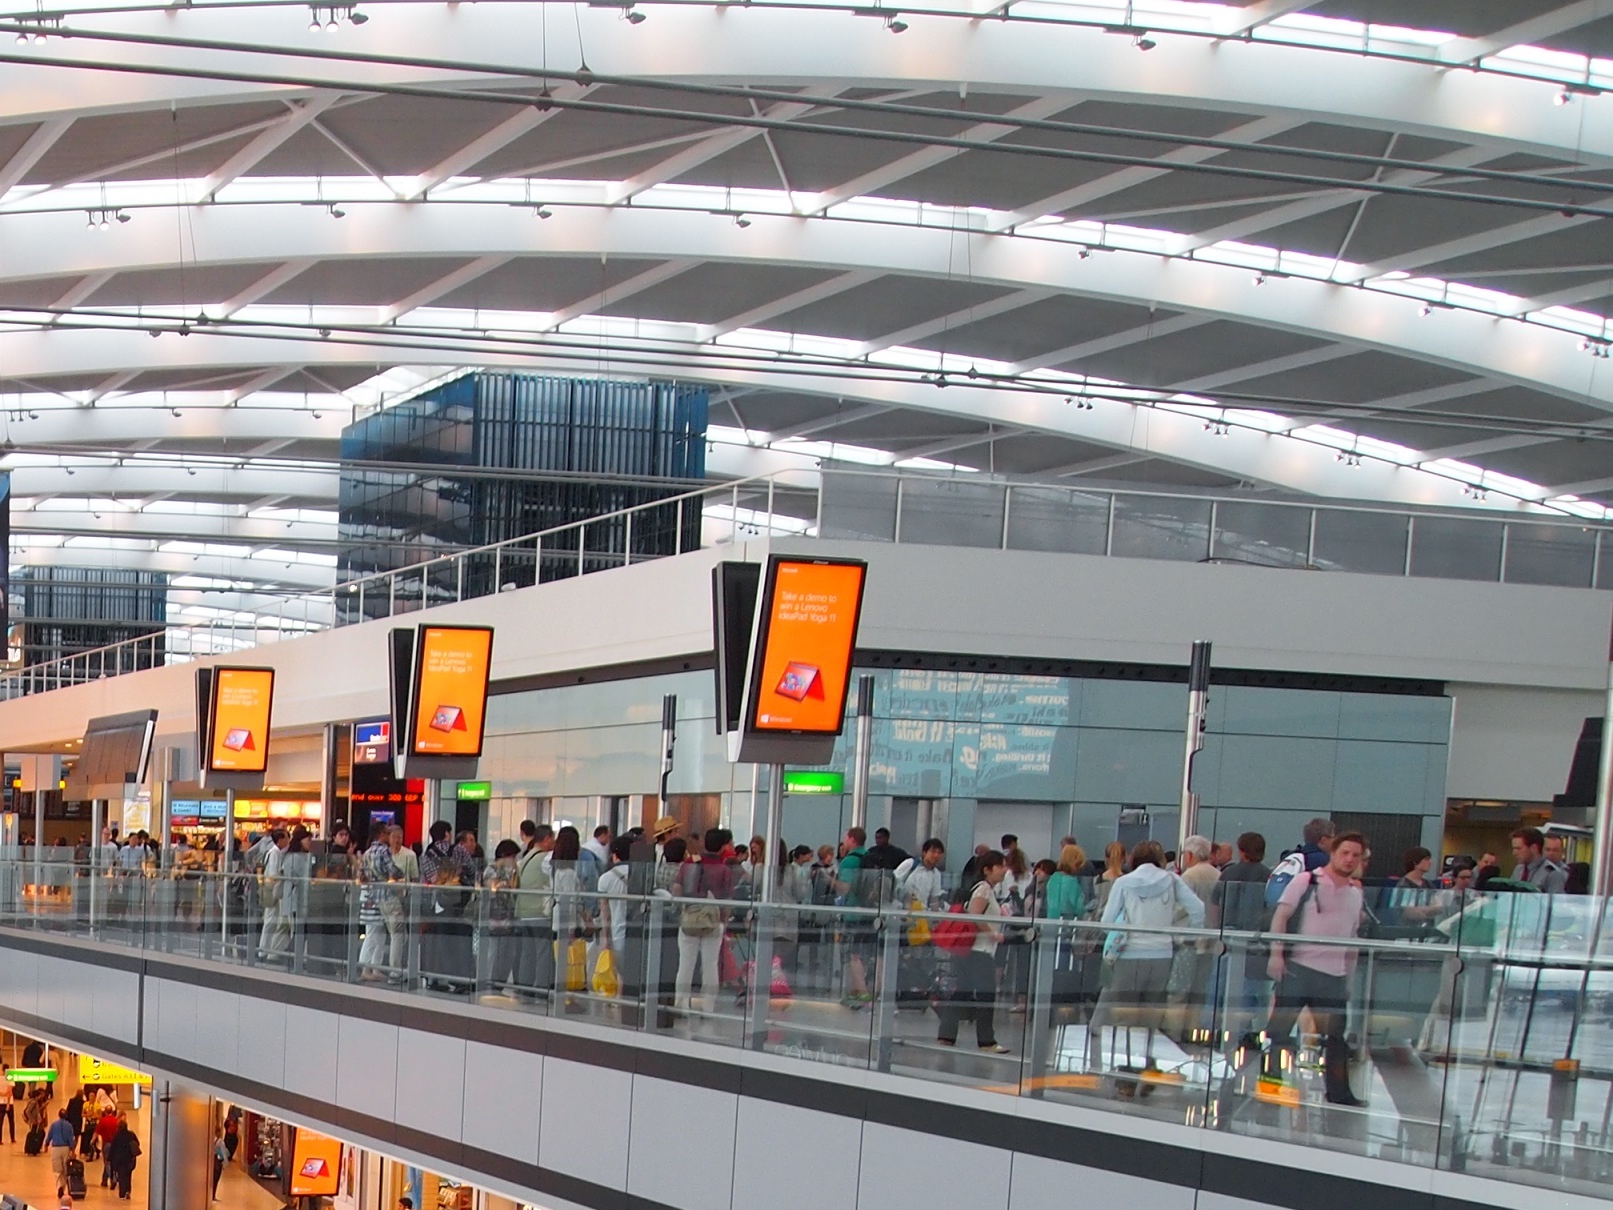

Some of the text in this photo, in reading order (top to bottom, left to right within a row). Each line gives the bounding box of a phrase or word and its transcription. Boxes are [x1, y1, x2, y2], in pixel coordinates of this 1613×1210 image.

[781, 591, 797, 601] Take
[805, 592, 828, 602] demo
[828, 594, 837, 603] to
[779, 602, 793, 610] win
[801, 602, 829, 612] Lenovo
[778, 611, 809, 621] IdeaPad
[810, 612, 828, 624] Yoga
